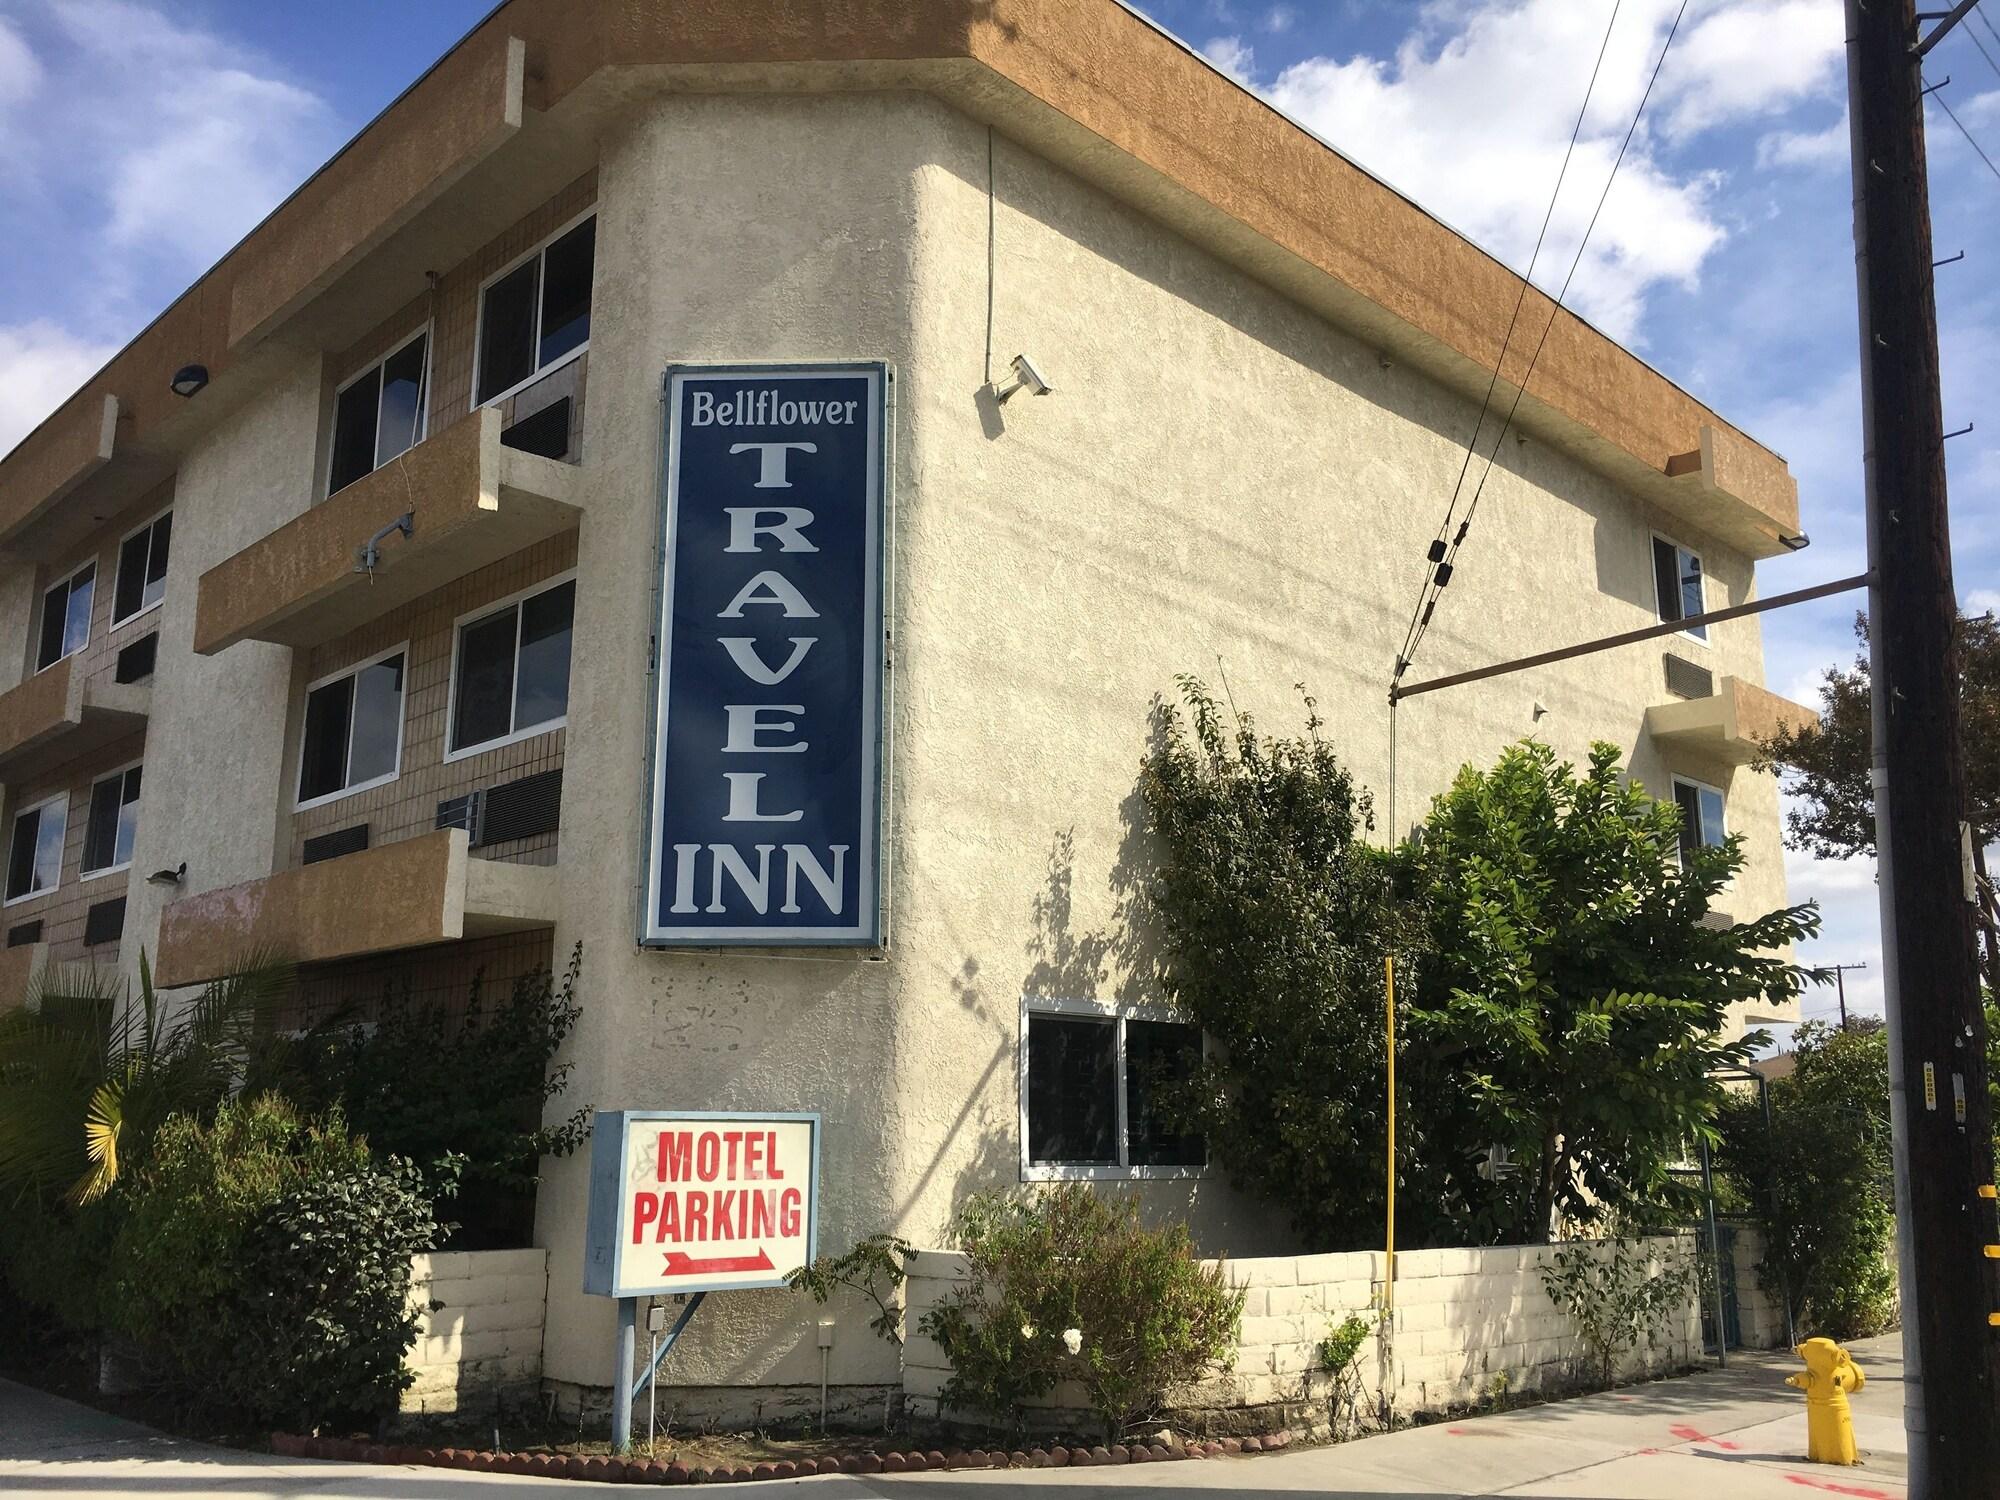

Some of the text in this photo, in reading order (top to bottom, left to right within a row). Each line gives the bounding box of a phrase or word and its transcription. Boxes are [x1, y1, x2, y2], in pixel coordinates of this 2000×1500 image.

[691, 389, 858, 426] Bellflower
[716, 442, 820, 822] TRAVEL
[670, 844, 850, 915] INN
[657, 1131, 784, 1183] MOTEL
[632, 1187, 801, 1245] PARKING
